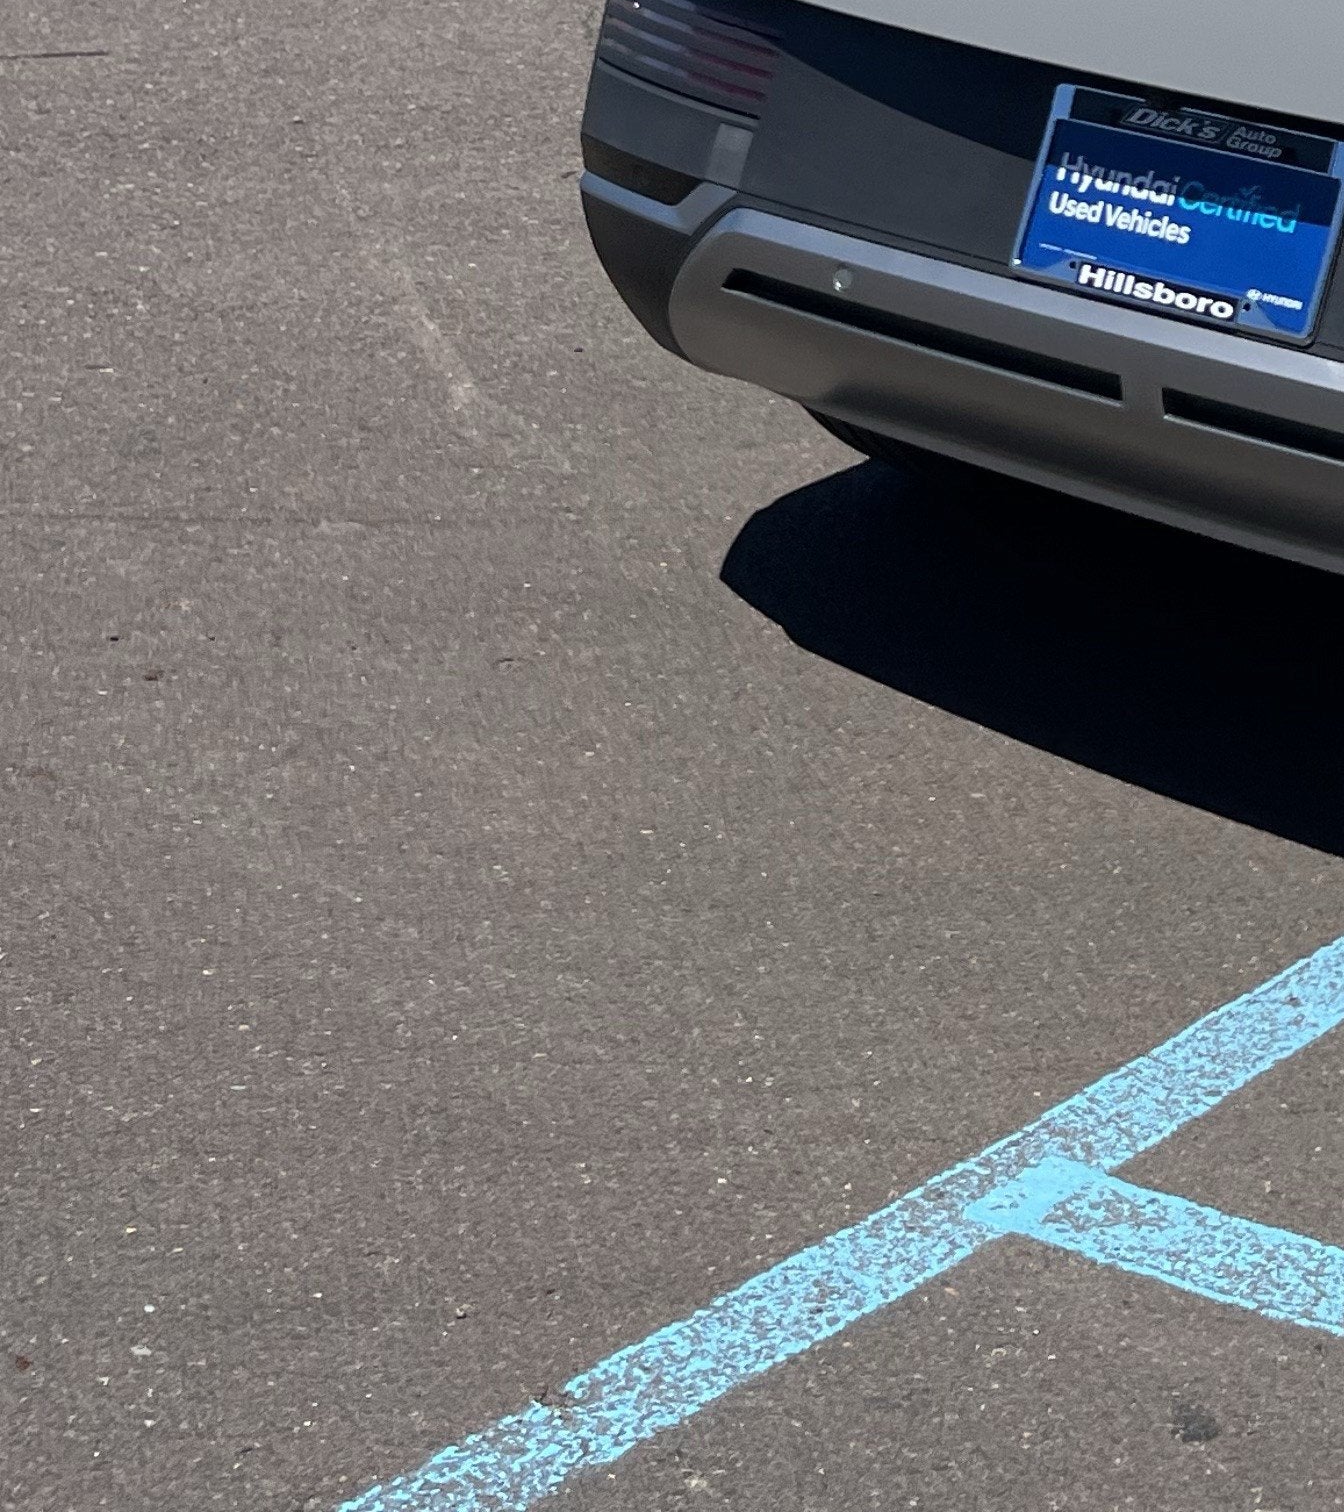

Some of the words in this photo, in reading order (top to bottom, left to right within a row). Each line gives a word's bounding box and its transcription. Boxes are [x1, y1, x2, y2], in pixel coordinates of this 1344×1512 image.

[1126, 106, 1222, 140] Dick's
[1233, 125, 1278, 145] Auto
[1226, 135, 1283, 159] Group
[1055, 151, 1181, 207] Hyundai
[1177, 180, 1301, 234] Certified
[1048, 190, 1105, 224] Used
[1105, 203, 1192, 245] Vehicles
[1078, 263, 1235, 321] Hillsboro
